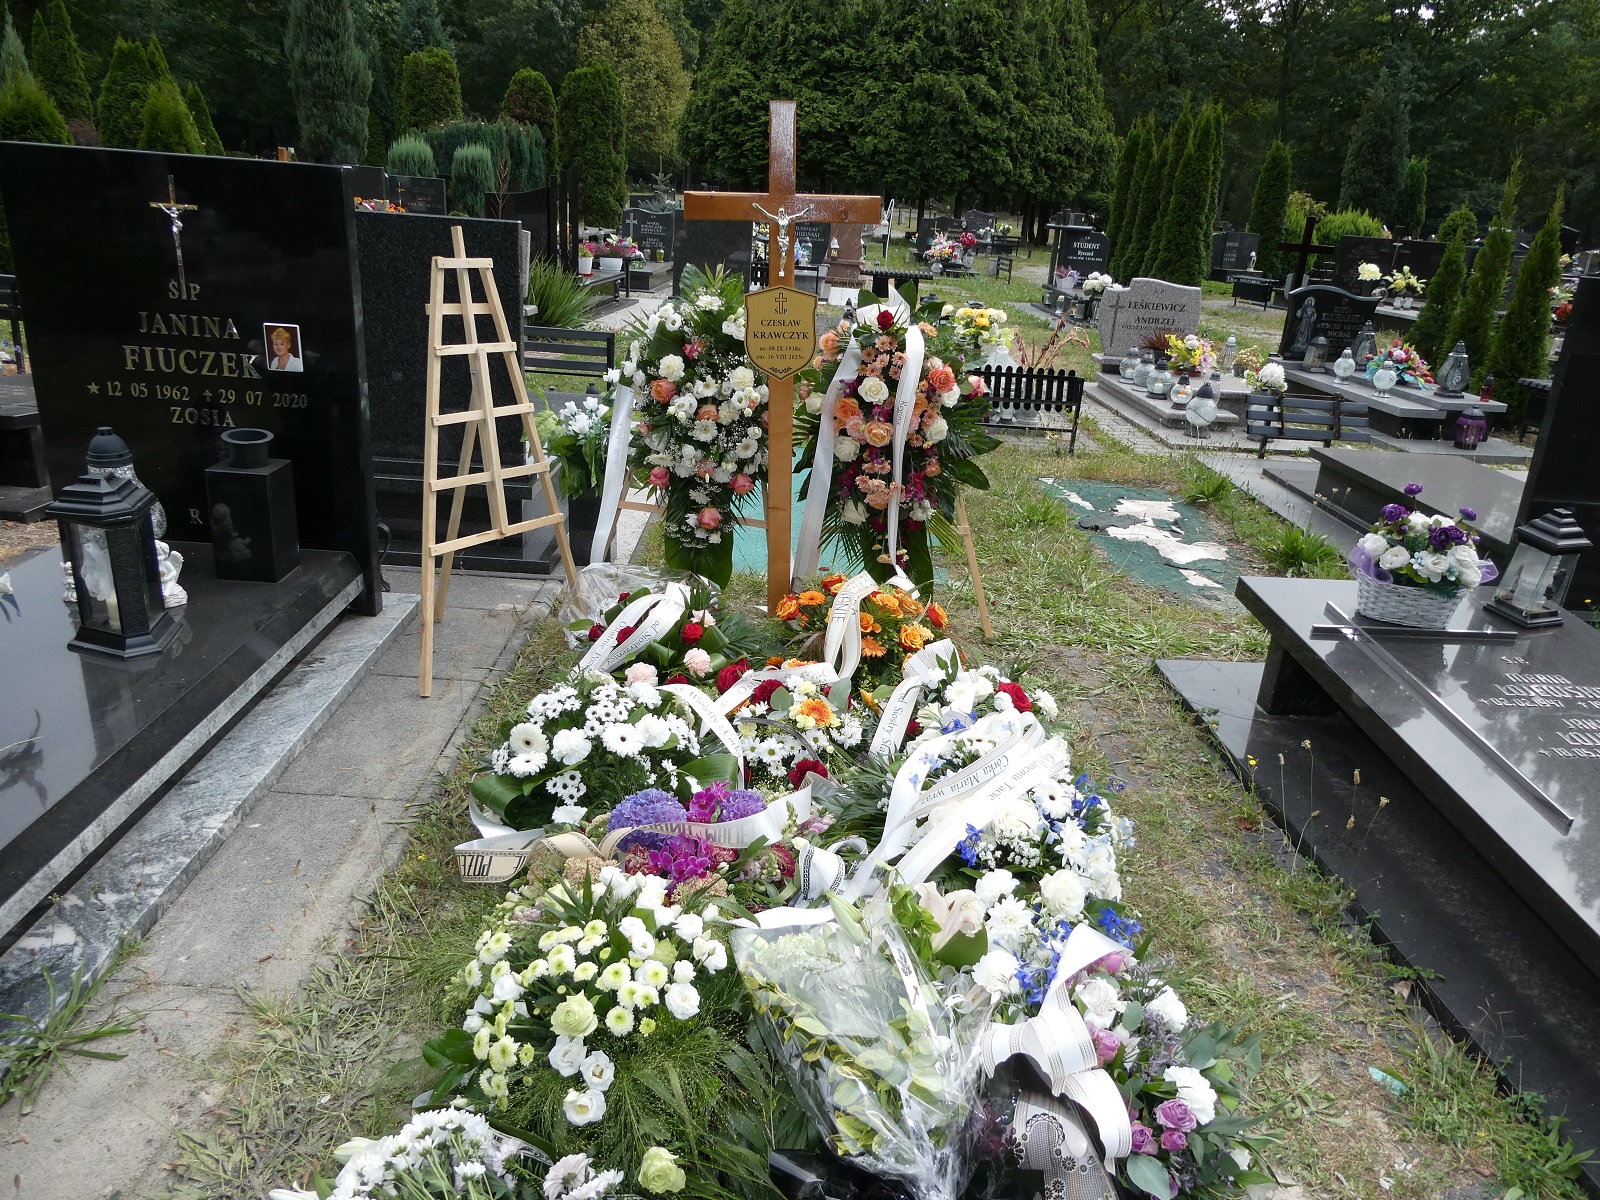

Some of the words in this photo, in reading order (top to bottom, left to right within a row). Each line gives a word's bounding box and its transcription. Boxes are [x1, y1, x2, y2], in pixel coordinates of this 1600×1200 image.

[1073, 241, 1101, 250] STUDENT
[1127, 300, 1187, 313] LEŚKIEWICZ
[139, 311, 241, 341] JANINA
[760, 319, 801, 327] CZESŁAW
[1134, 317, 1176, 326] ANDRZEJ
[753, 331, 810, 340] KRAWCZYK
[122, 345, 263, 380] FIUCZEK
[106, 381, 122, 398] 12
[130, 382, 148, 399] 05
[156, 384, 191, 401] 1962
[219, 388, 236, 405] 29
[246, 390, 263, 407] 07
[273, 392, 308, 409] 2020
[171, 406, 236, 428] ZOSIA
[1504, 672, 1572, 684] MARIA
[1489, 697, 1566, 709] 02.02.1947
[883, 706, 904, 737] Siostry
[981, 755, 1009, 776] Córka
[950, 772, 981, 793] Maria
[987, 782, 1015, 802] Tacie
